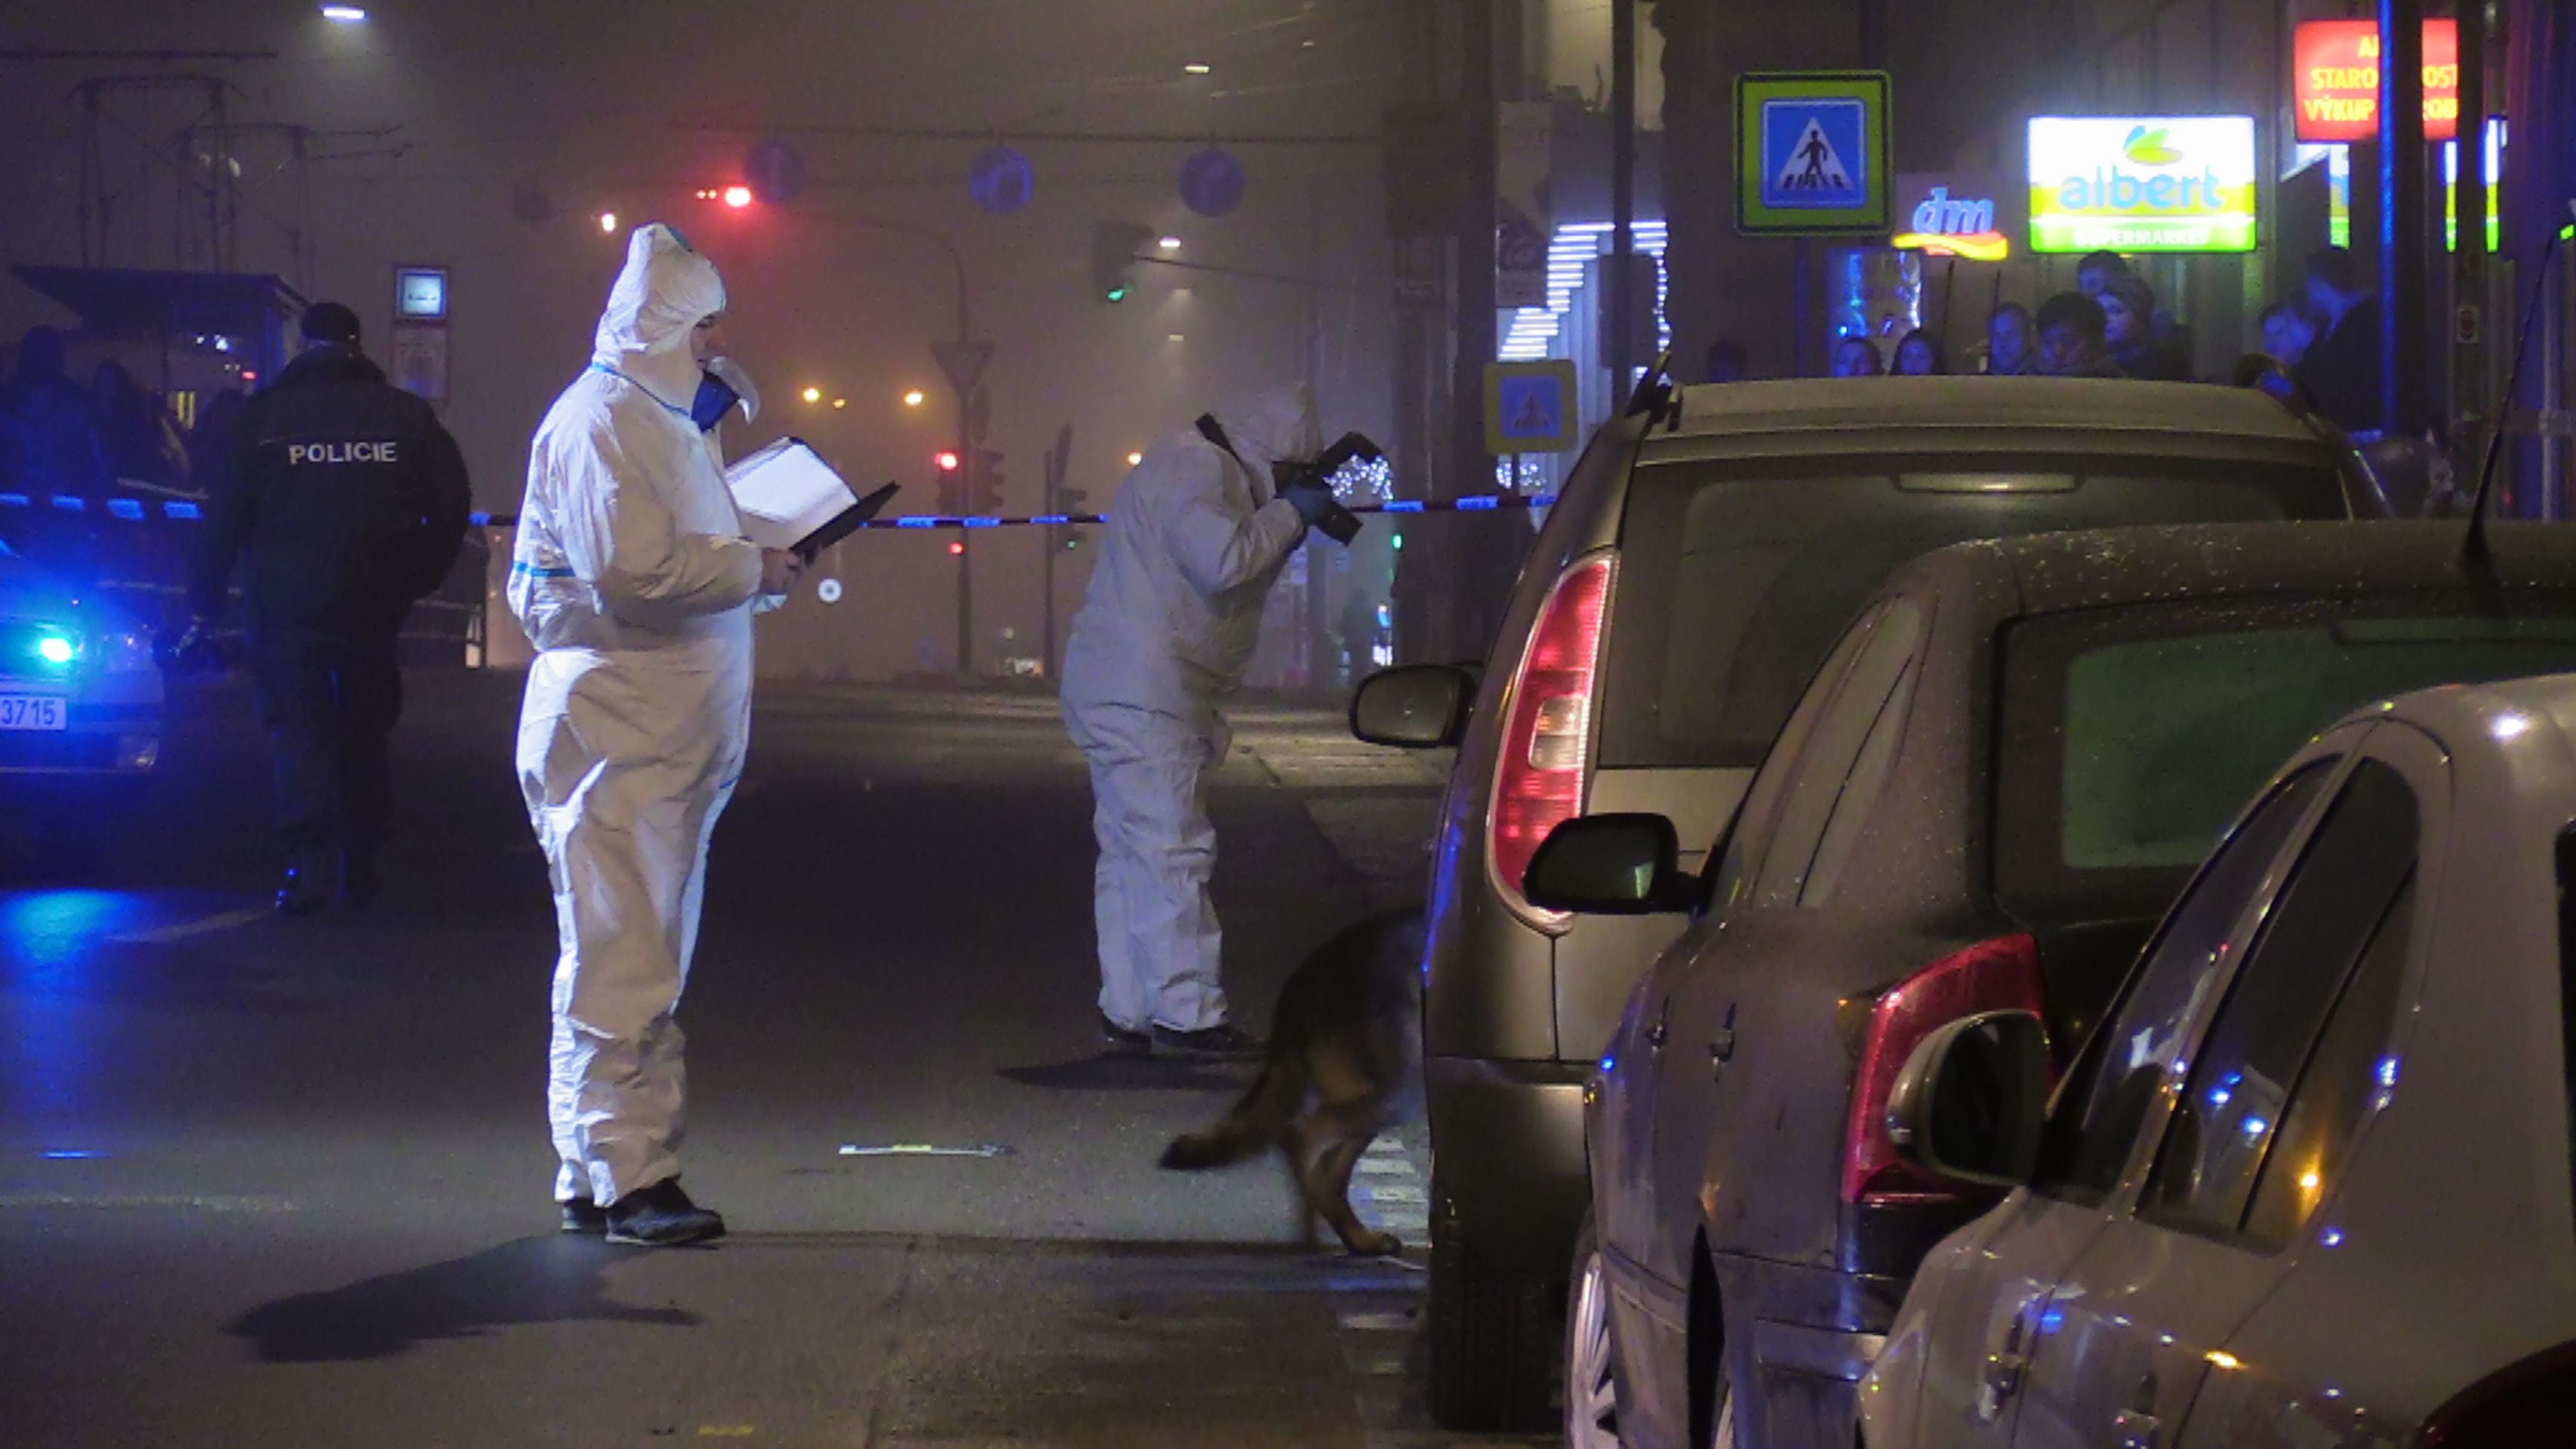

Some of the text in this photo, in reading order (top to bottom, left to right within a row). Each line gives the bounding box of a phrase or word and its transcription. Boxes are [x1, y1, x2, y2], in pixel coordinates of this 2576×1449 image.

[2304, 94, 2375, 121] VÝKUP
[2059, 165, 2224, 209] albert
[1913, 186, 1995, 234] dm
[289, 441, 398, 465] POLICIE
[2, 699, 57, 724] 3715
